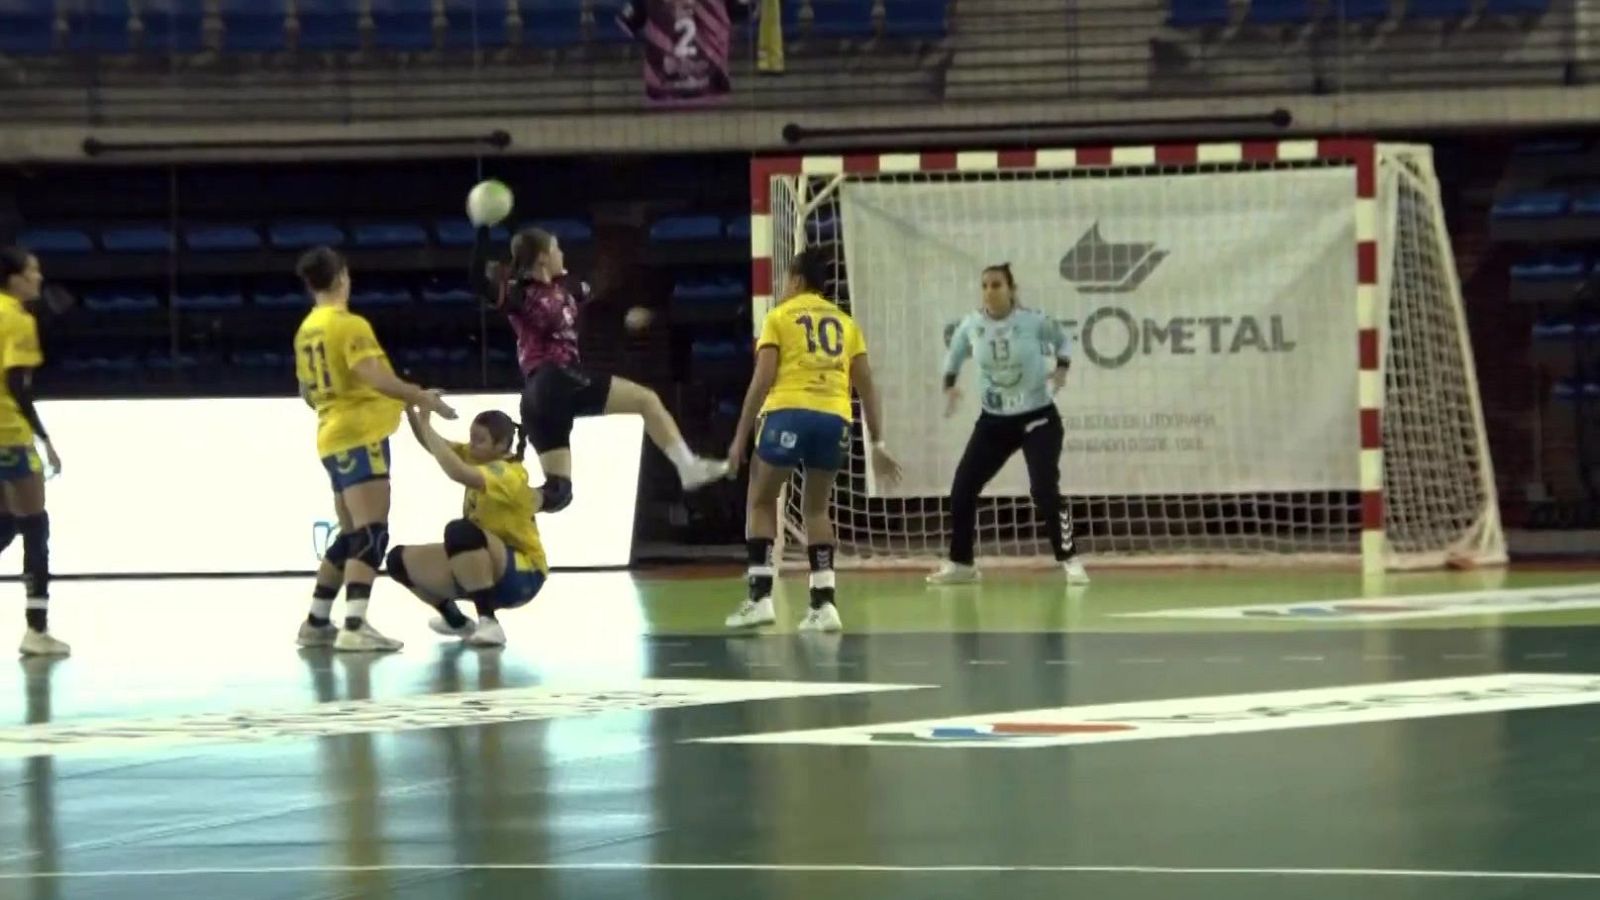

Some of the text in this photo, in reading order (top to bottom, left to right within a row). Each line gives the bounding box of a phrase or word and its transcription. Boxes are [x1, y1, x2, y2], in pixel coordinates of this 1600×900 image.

[674, 17, 697, 57] 2
[796, 314, 844, 357] 10
[944, 306, 1297, 369] FOMETAL
[989, 338, 1010, 361] 13
